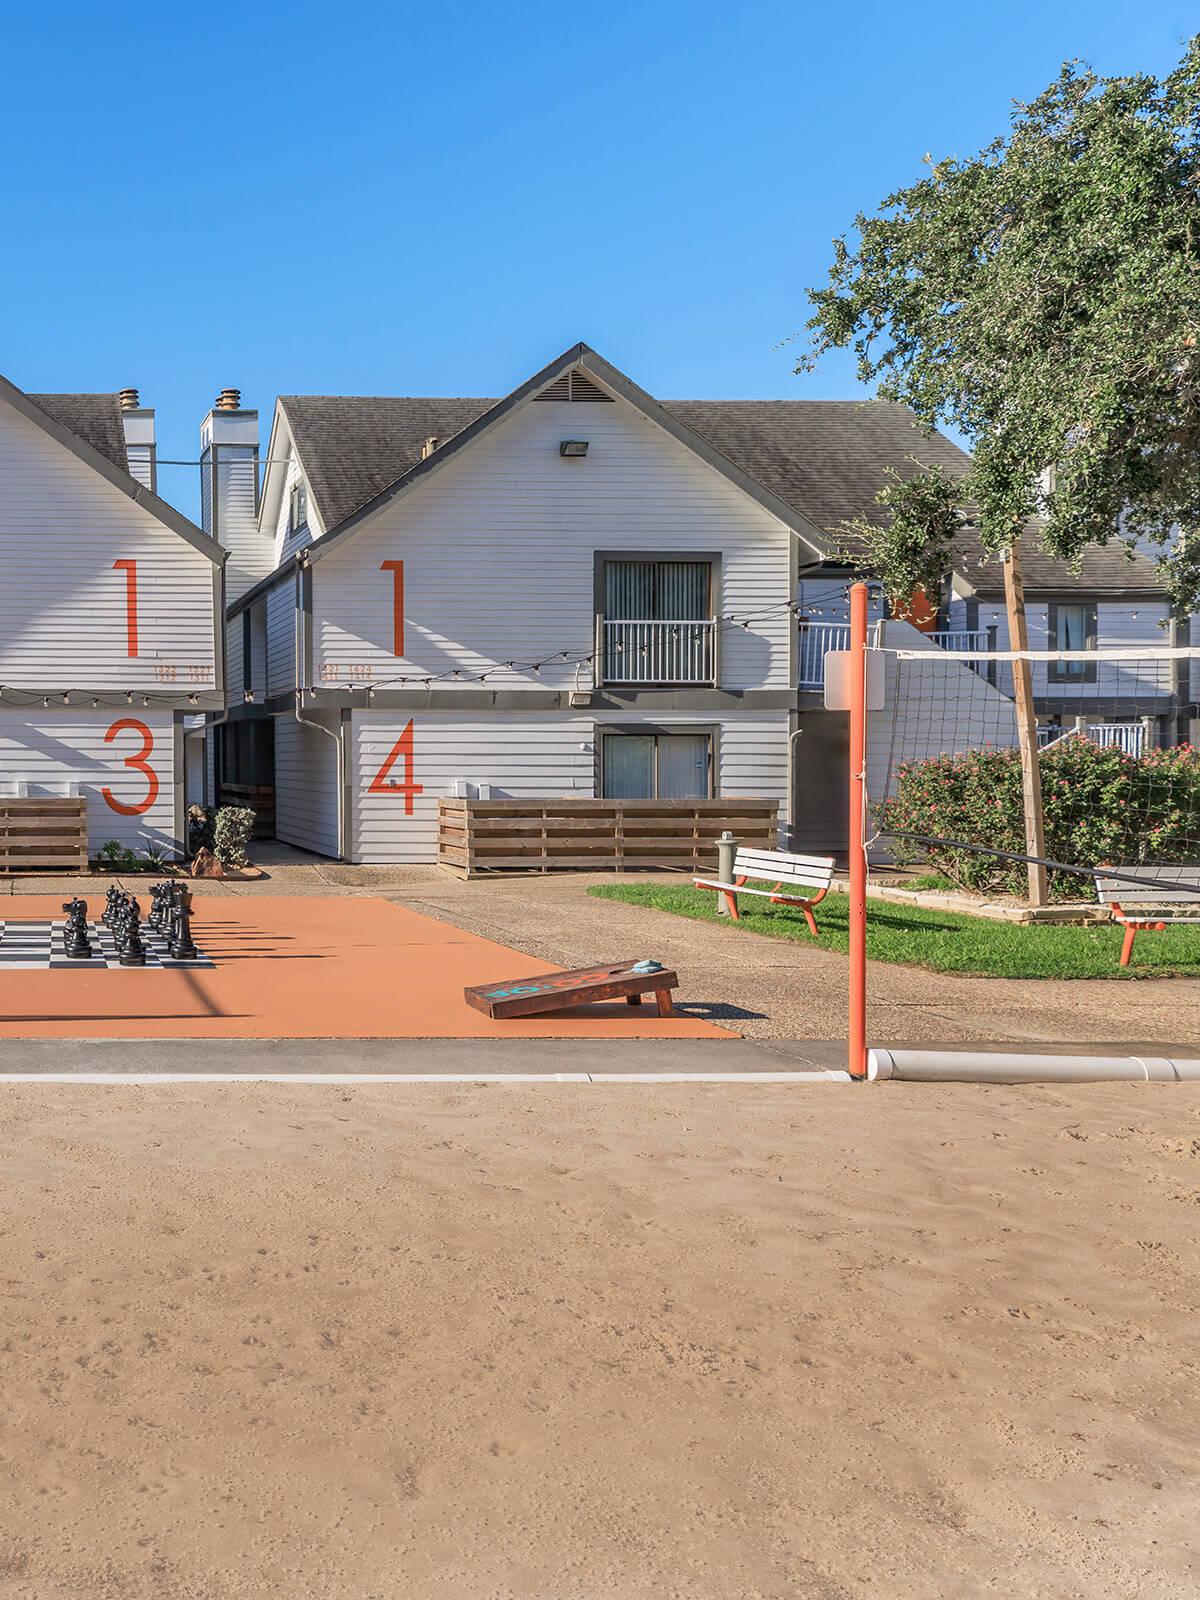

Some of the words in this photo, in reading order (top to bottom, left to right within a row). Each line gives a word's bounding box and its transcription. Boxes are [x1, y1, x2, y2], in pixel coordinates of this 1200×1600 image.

[112, 559, 139, 657] 1
[380, 559, 405, 657] 1
[101, 718, 159, 816] 3
[367, 719, 424, 816] 4
